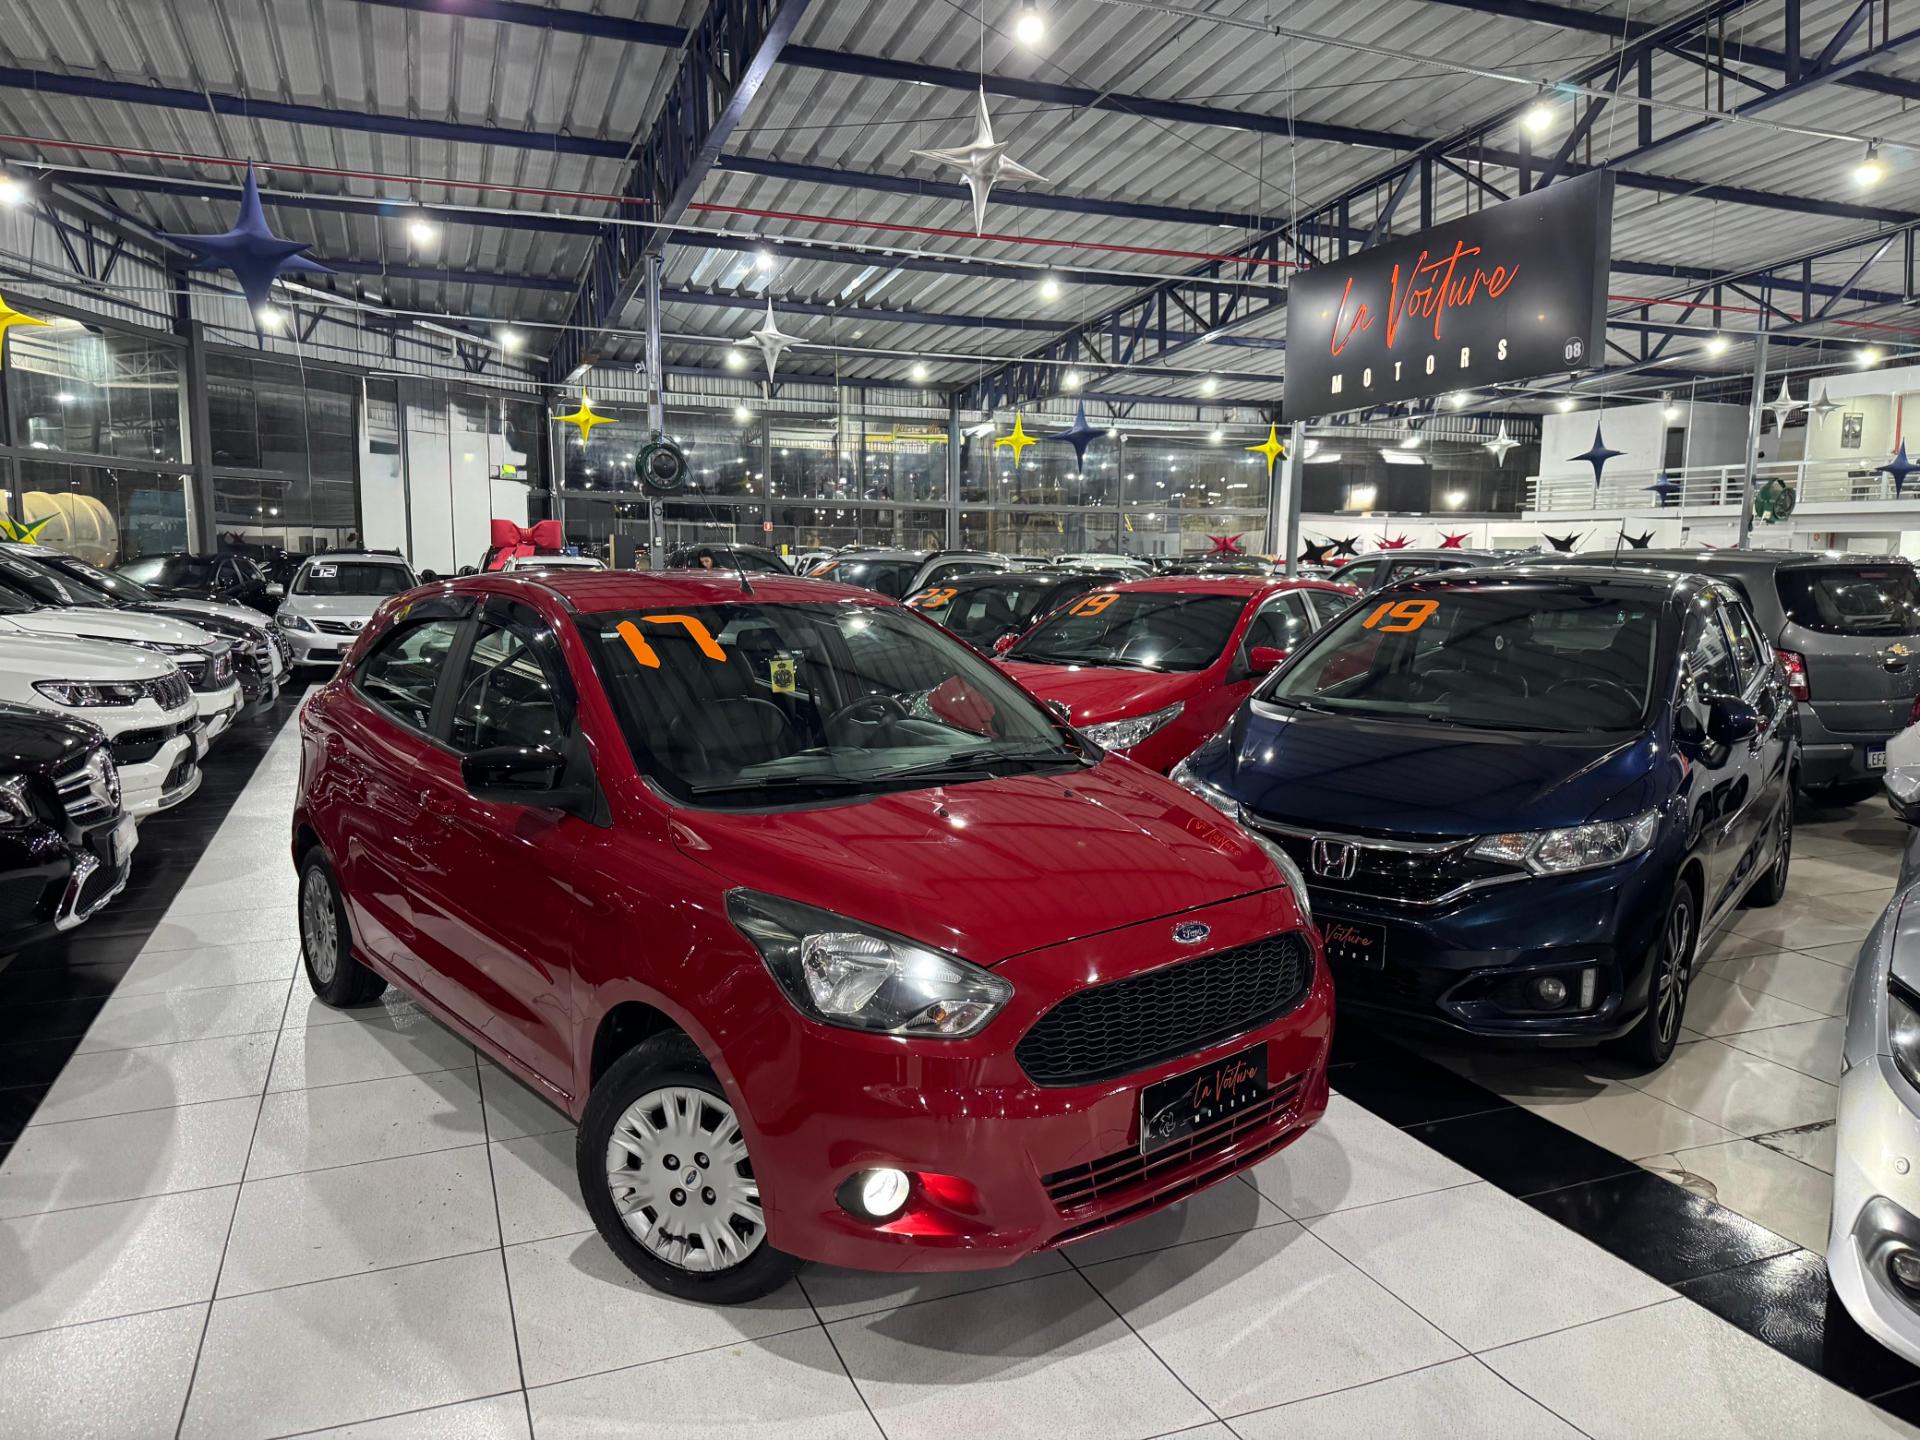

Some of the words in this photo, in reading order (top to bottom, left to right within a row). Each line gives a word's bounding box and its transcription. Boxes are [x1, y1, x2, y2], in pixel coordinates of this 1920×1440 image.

[1331, 277, 1376, 358] La
[1386, 240, 1520, 349] Voiture
[1331, 338, 1508, 394] MOTORS
[1564, 341, 1582, 361] 08
[1068, 593, 1121, 617] 19
[1361, 599, 1441, 633] 19
[615, 614, 728, 670] 17
[1216, 1060, 1258, 1101] Voiture
